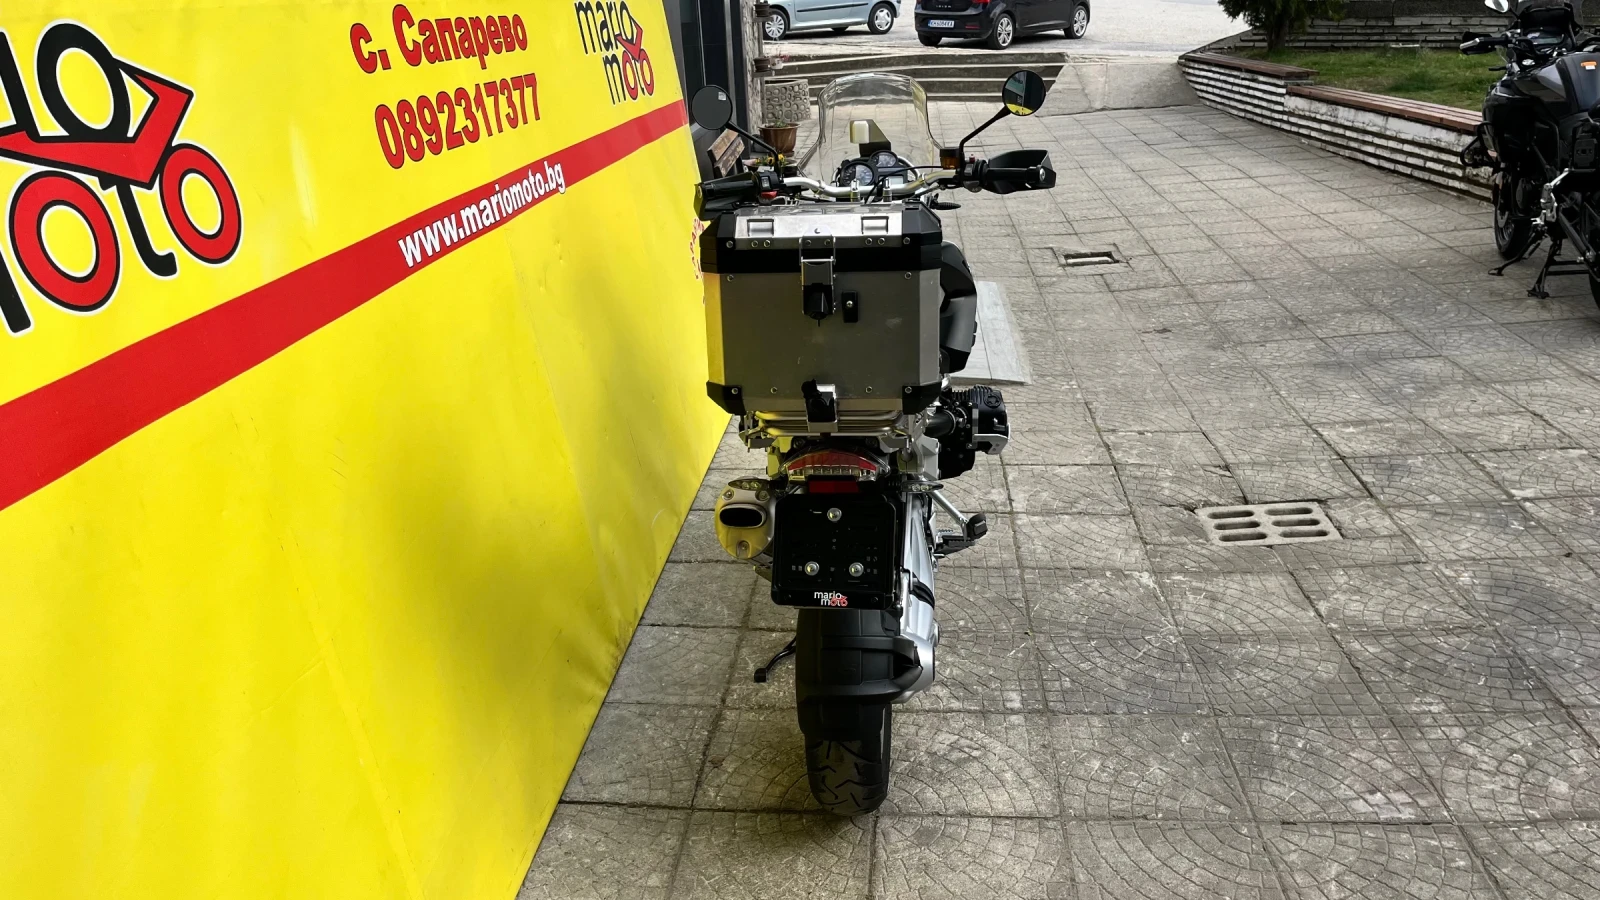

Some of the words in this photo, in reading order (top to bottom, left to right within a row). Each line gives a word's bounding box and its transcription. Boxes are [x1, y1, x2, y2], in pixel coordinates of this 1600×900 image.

[393, 4, 528, 70] Сапарево
[575, 1, 634, 54] mario
[602, 49, 654, 105] moto
[375, 73, 541, 170] 0892317377
[0, 144, 242, 334] oto
[398, 160, 566, 268] www.mariomoto.bg
[813, 591, 842, 599] mario
[820, 598, 848, 606] moto
